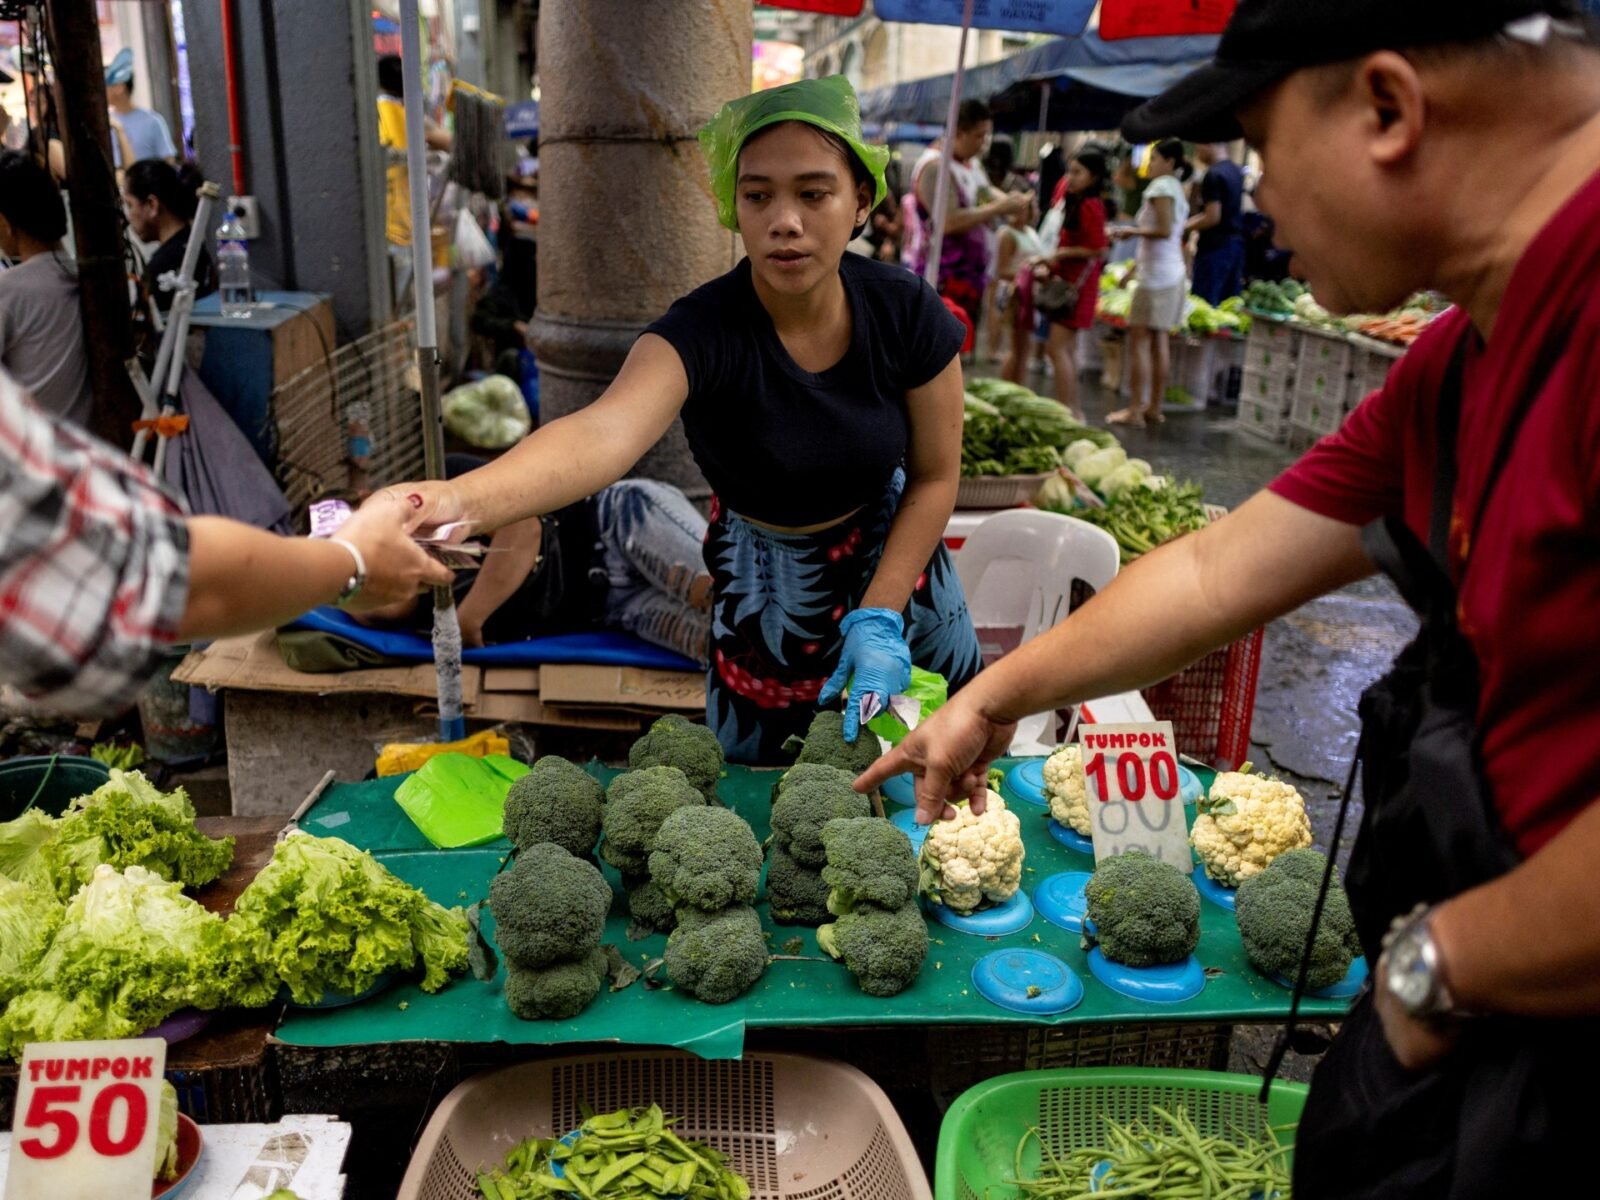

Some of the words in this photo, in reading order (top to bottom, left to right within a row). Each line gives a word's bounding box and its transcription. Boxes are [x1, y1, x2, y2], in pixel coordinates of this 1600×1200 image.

[1084, 733, 1166, 749] TUMPOK
[1085, 751, 1178, 802] 100
[28, 1057, 153, 1082] TUMPOK
[20, 1082, 148, 1160] 50
